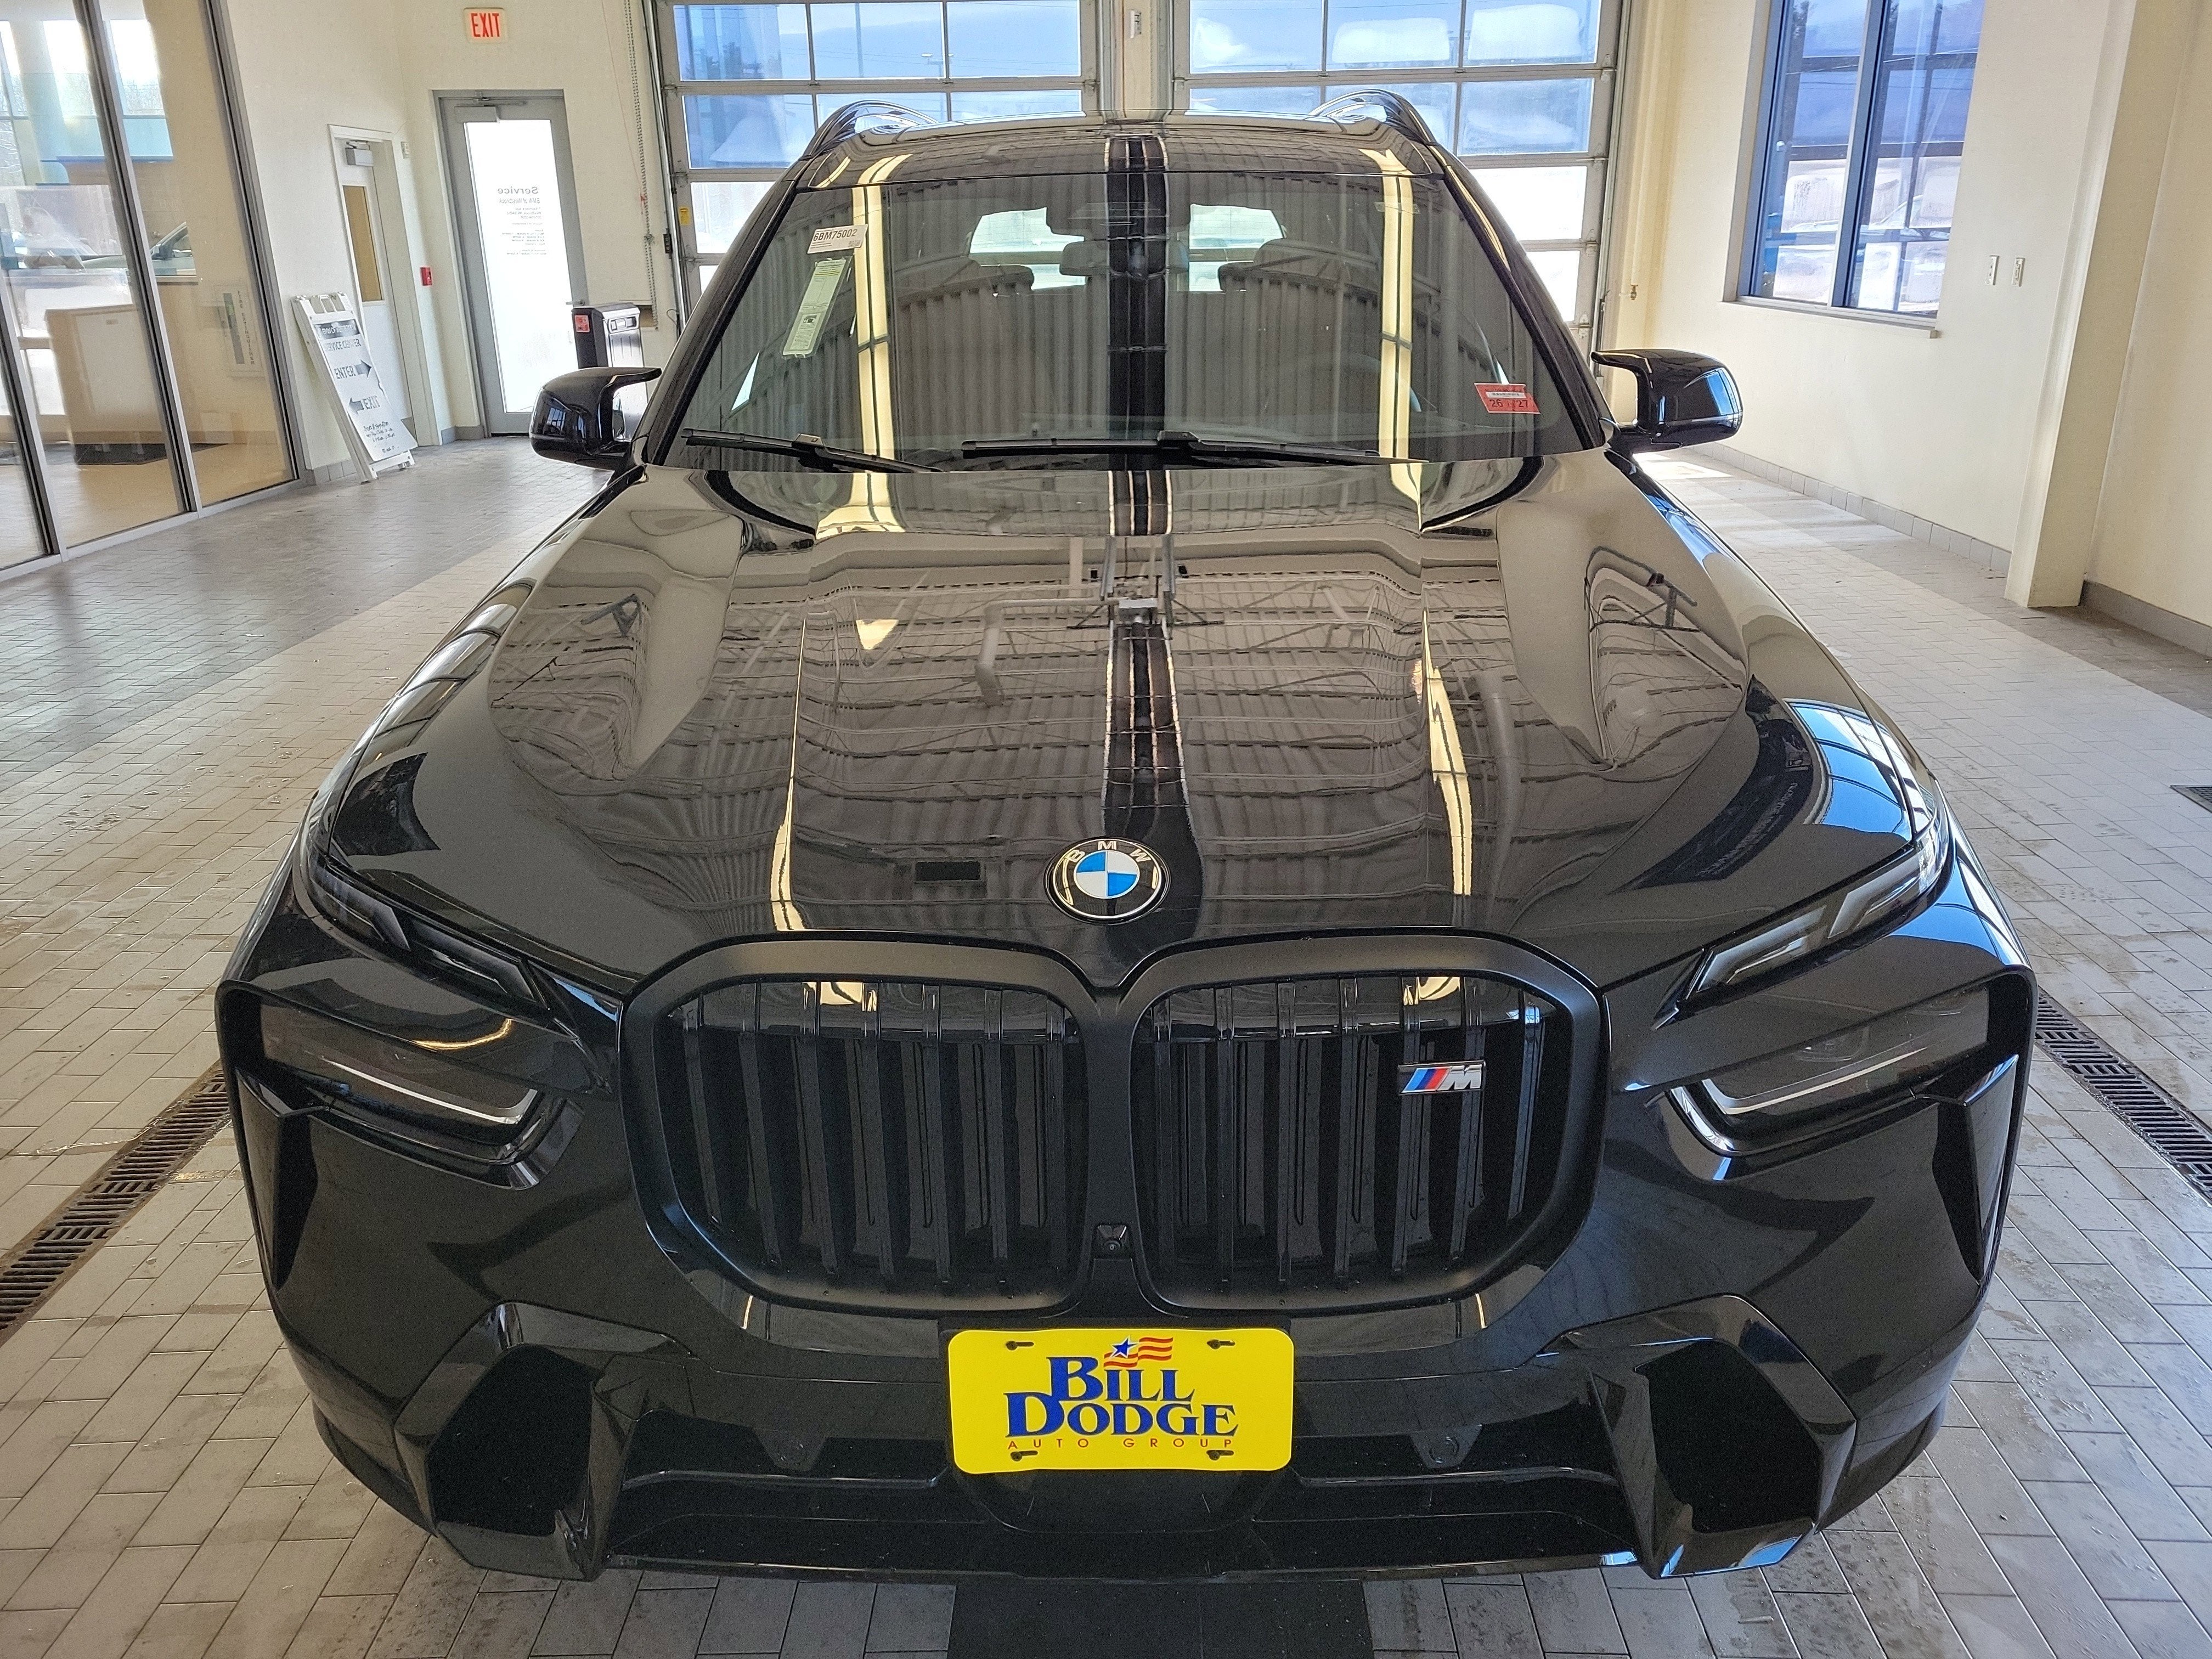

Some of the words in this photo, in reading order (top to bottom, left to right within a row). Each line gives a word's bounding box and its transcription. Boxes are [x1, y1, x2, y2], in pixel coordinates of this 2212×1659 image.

[471, 13, 500, 37] EXIT
[813, 229, 857, 241] 6BM75002
[342, 338, 362, 349] CEER
[334, 365, 356, 379] ENTER
[362, 395, 380, 410] EXIT
[1489, 399, 1503, 407] 26
[1065, 840, 1152, 863] BMW
[1047, 1356, 1195, 1401] BILL
[1003, 1391, 1239, 1438] DODGE
[1007, 1437, 1090, 1450] AUTO
[1123, 1437, 1233, 1448] GROUP
